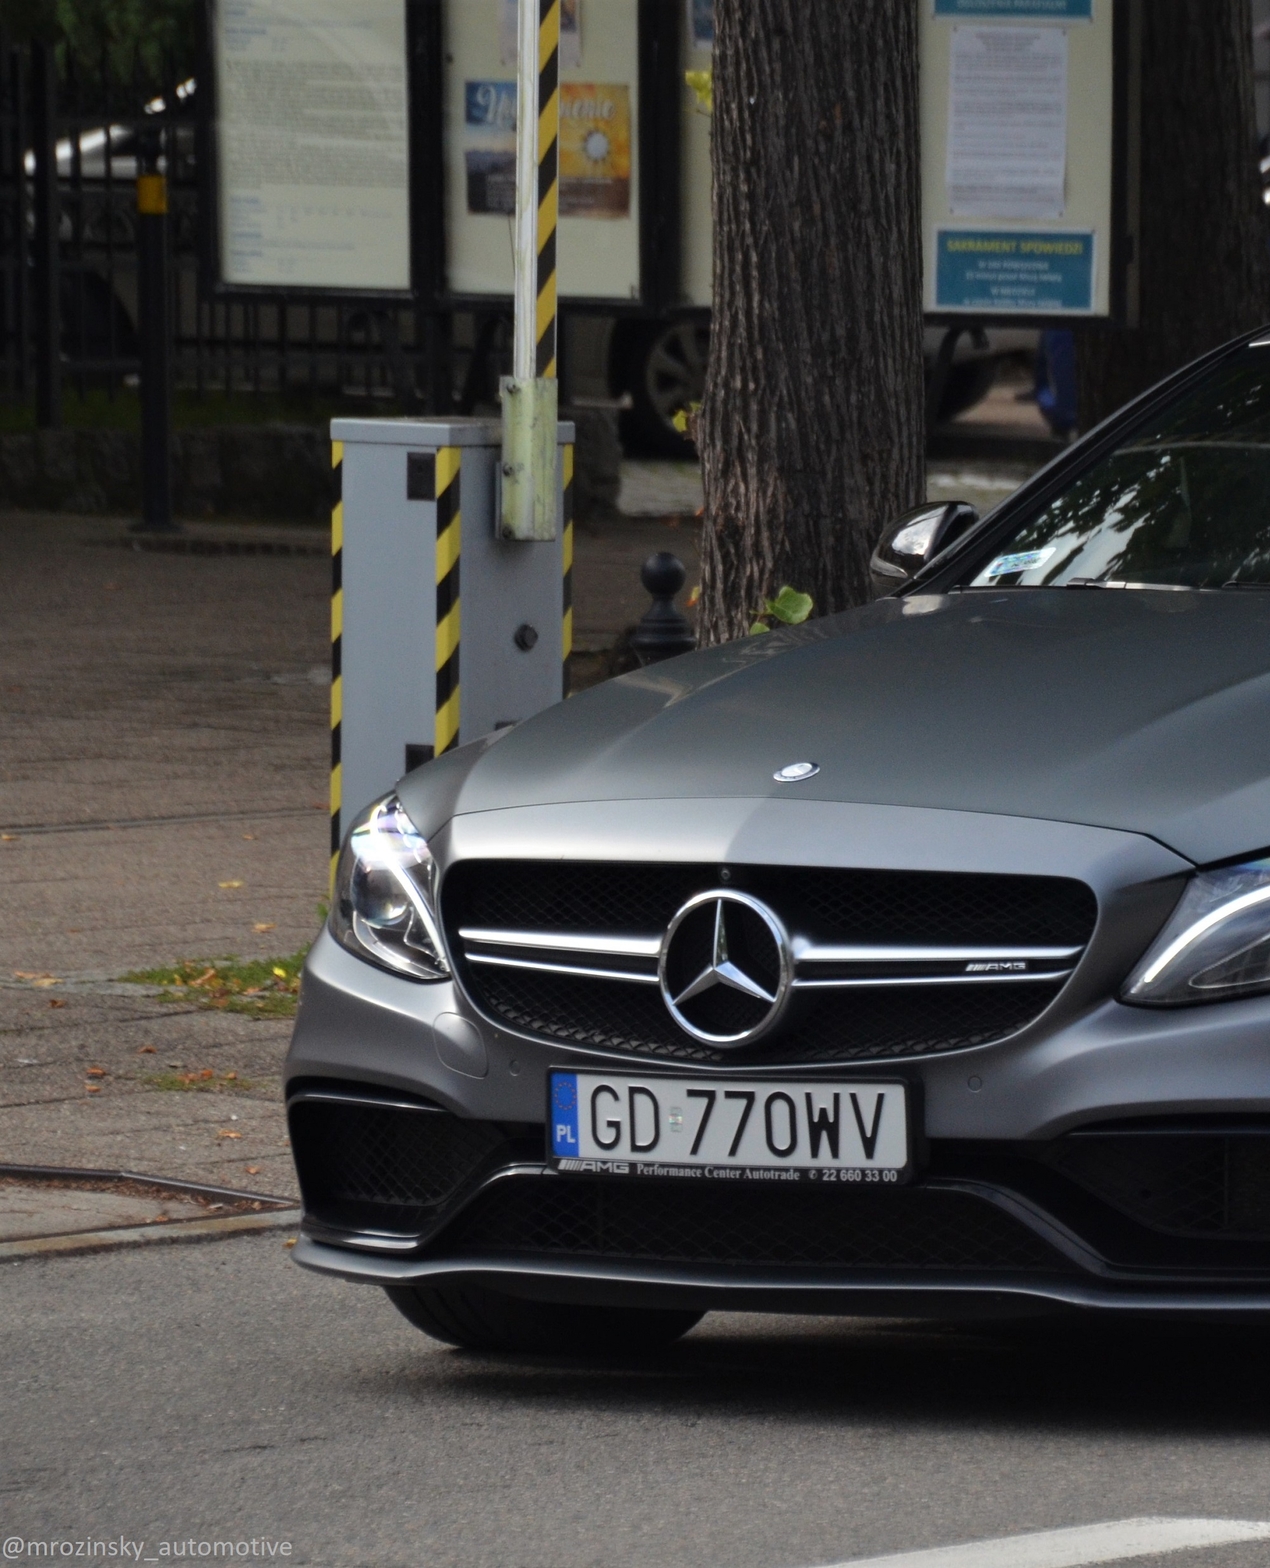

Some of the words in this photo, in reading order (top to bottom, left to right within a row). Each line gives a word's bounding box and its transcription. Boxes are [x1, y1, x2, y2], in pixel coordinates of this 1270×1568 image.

[985, 962, 1026, 971] AMG
[590, 1084, 660, 1153] GD
[686, 1088, 885, 1160] 770WV
[556, 1125, 576, 1143] PL
[581, 1161, 629, 1174] AMG
[637, 1163, 702, 1178] Performance
[704, 1166, 741, 1179] Center
[743, 1167, 800, 1181] Autotrade
[822, 1170, 837, 1181] 22
[840, 1170, 862, 1181] 660
[865, 1170, 880, 1182] 33
[882, 1170, 897, 1182] 00
